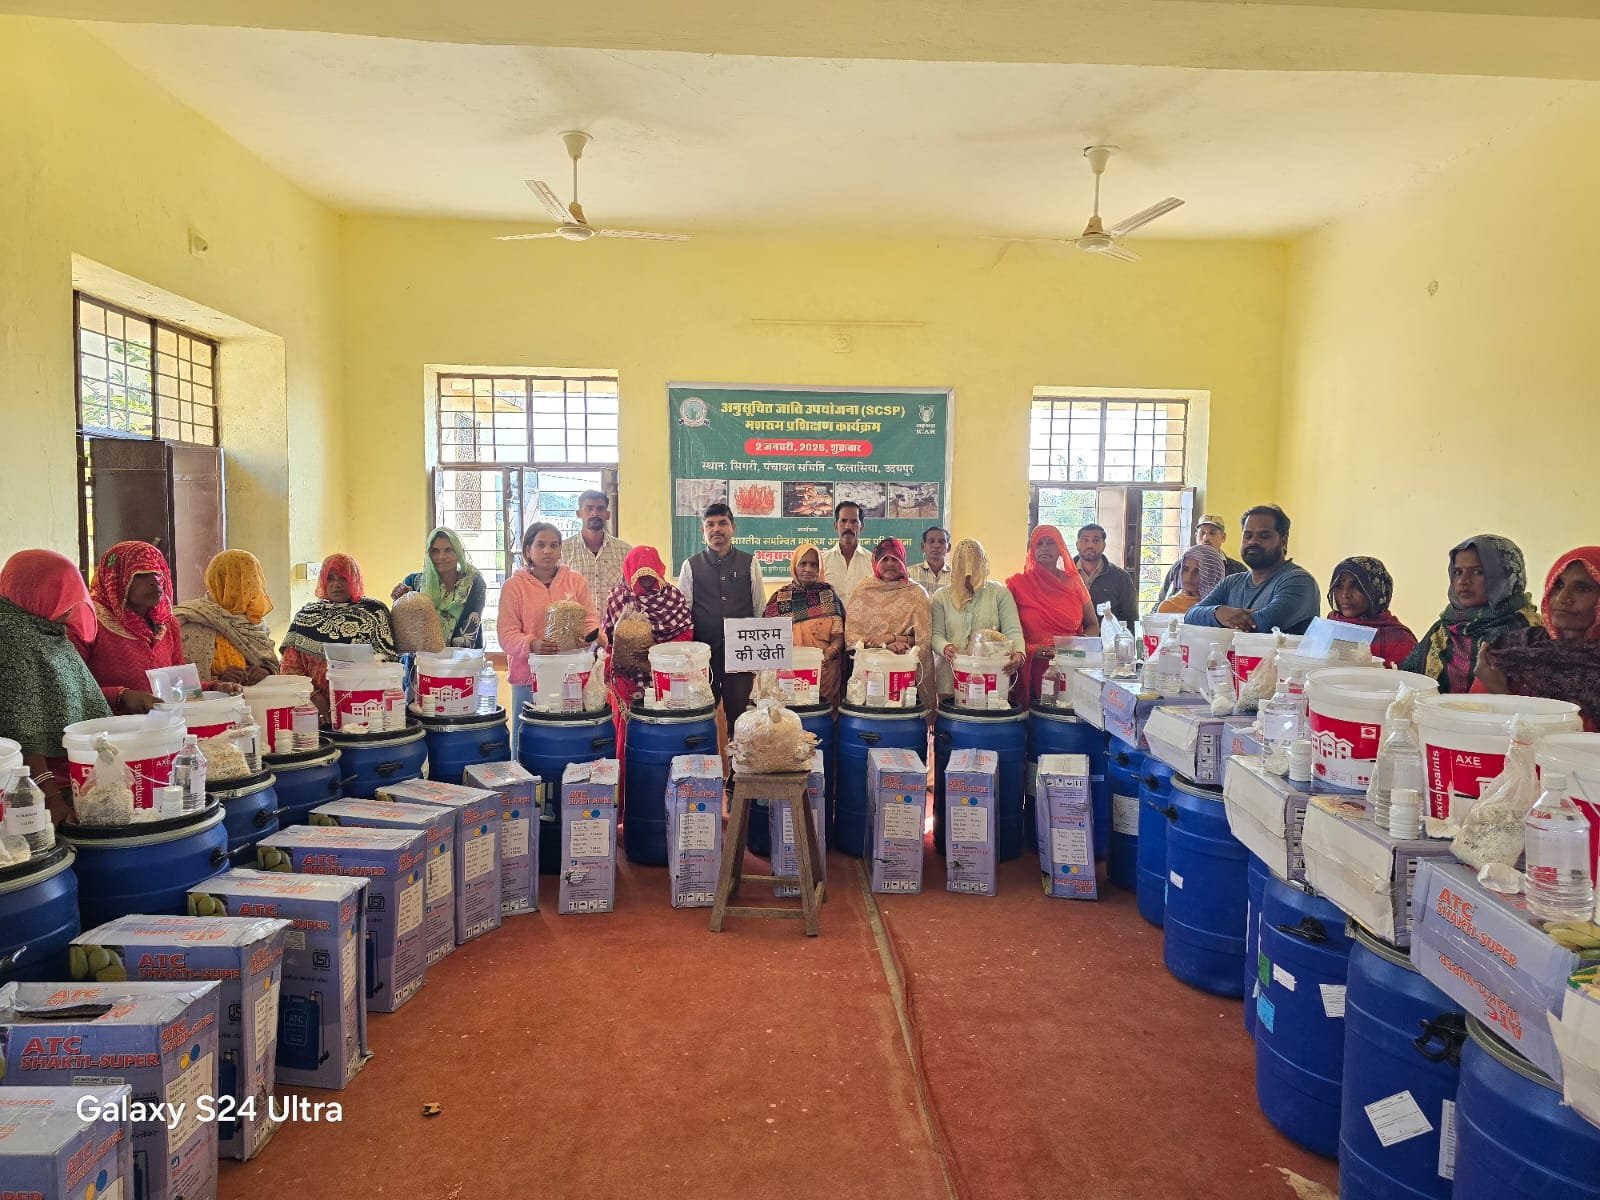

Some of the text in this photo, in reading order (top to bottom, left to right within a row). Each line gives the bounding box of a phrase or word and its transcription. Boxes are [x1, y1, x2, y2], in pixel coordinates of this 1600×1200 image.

[720, 401, 906, 418] अनुसूचित जाति उपयोजना (SCSP)
[786, 418, 833, 432] प्रशिक्षण
[835, 419, 881, 433] कार्यक्रम
[755, 443, 762, 452] 2
[830, 443, 862, 455] शुक्रवार
[702, 461, 727, 472] स्थान:
[762, 461, 795, 473] पंचायत
[797, 460, 826, 473] समिति
[883, 463, 914, 476] उदयपुर
[735, 643, 785, 661] की खेती
[1456, 755, 1480, 766] AXE
[135, 763, 144, 809] xionpaints
[303, 854, 336, 865] ATC
[239, 903, 279, 917] ATC
[1438, 887, 1474, 921] ATC
[1435, 902, 1518, 969] SHAKTI-SUPER
[138, 953, 186, 969] ATC
[21, 1035, 83, 1056] ATC
[20, 1053, 161, 1071] SHAKTI-SUPER
